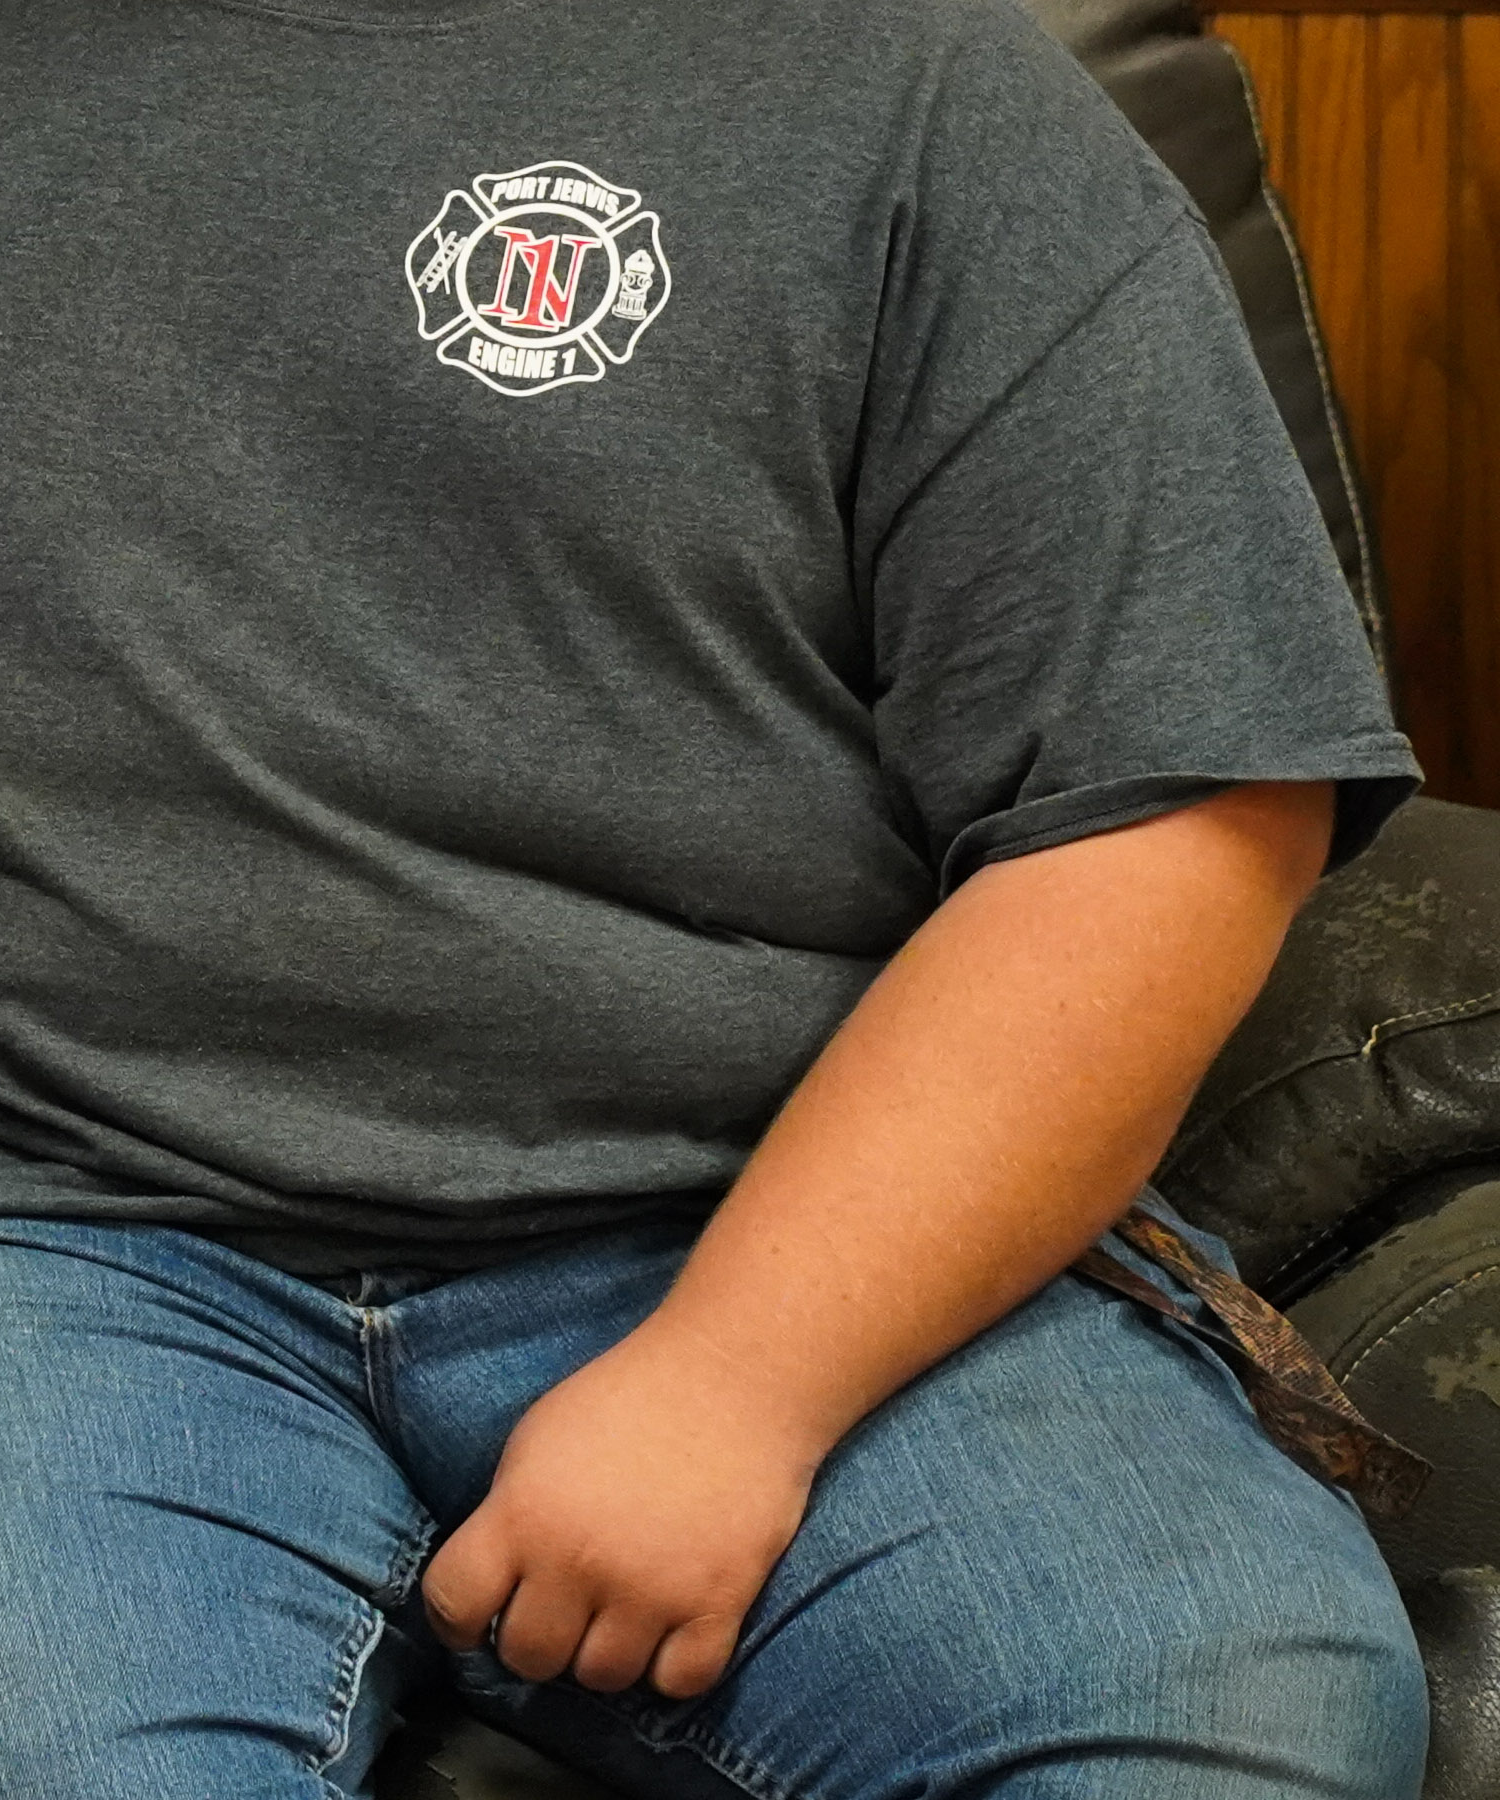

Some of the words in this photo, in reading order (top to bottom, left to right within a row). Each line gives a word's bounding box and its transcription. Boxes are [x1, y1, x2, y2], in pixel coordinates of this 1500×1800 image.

[491, 176, 550, 204] PORT
[551, 178, 620, 217] JERVIS
[467, 336, 557, 379] ENGINE
[559, 348, 577, 376] 1
